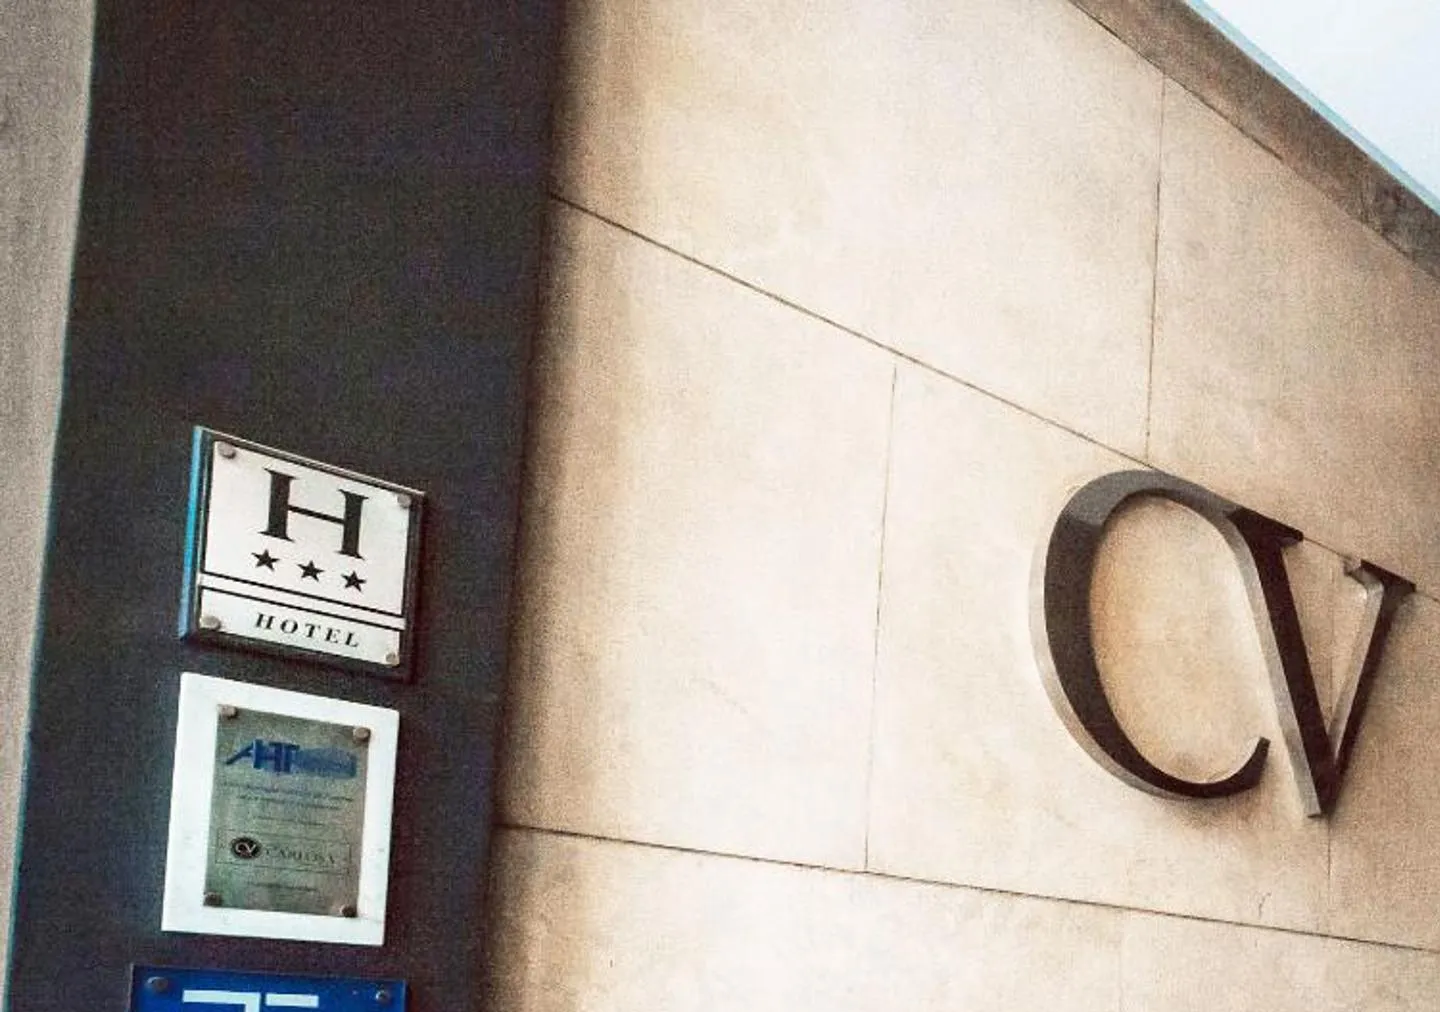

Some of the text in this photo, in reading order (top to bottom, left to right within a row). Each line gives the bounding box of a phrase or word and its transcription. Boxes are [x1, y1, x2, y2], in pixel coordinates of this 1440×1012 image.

[258, 467, 369, 560] H
[255, 612, 360, 648] HOTEL
[1028, 469, 1417, 818] CV
